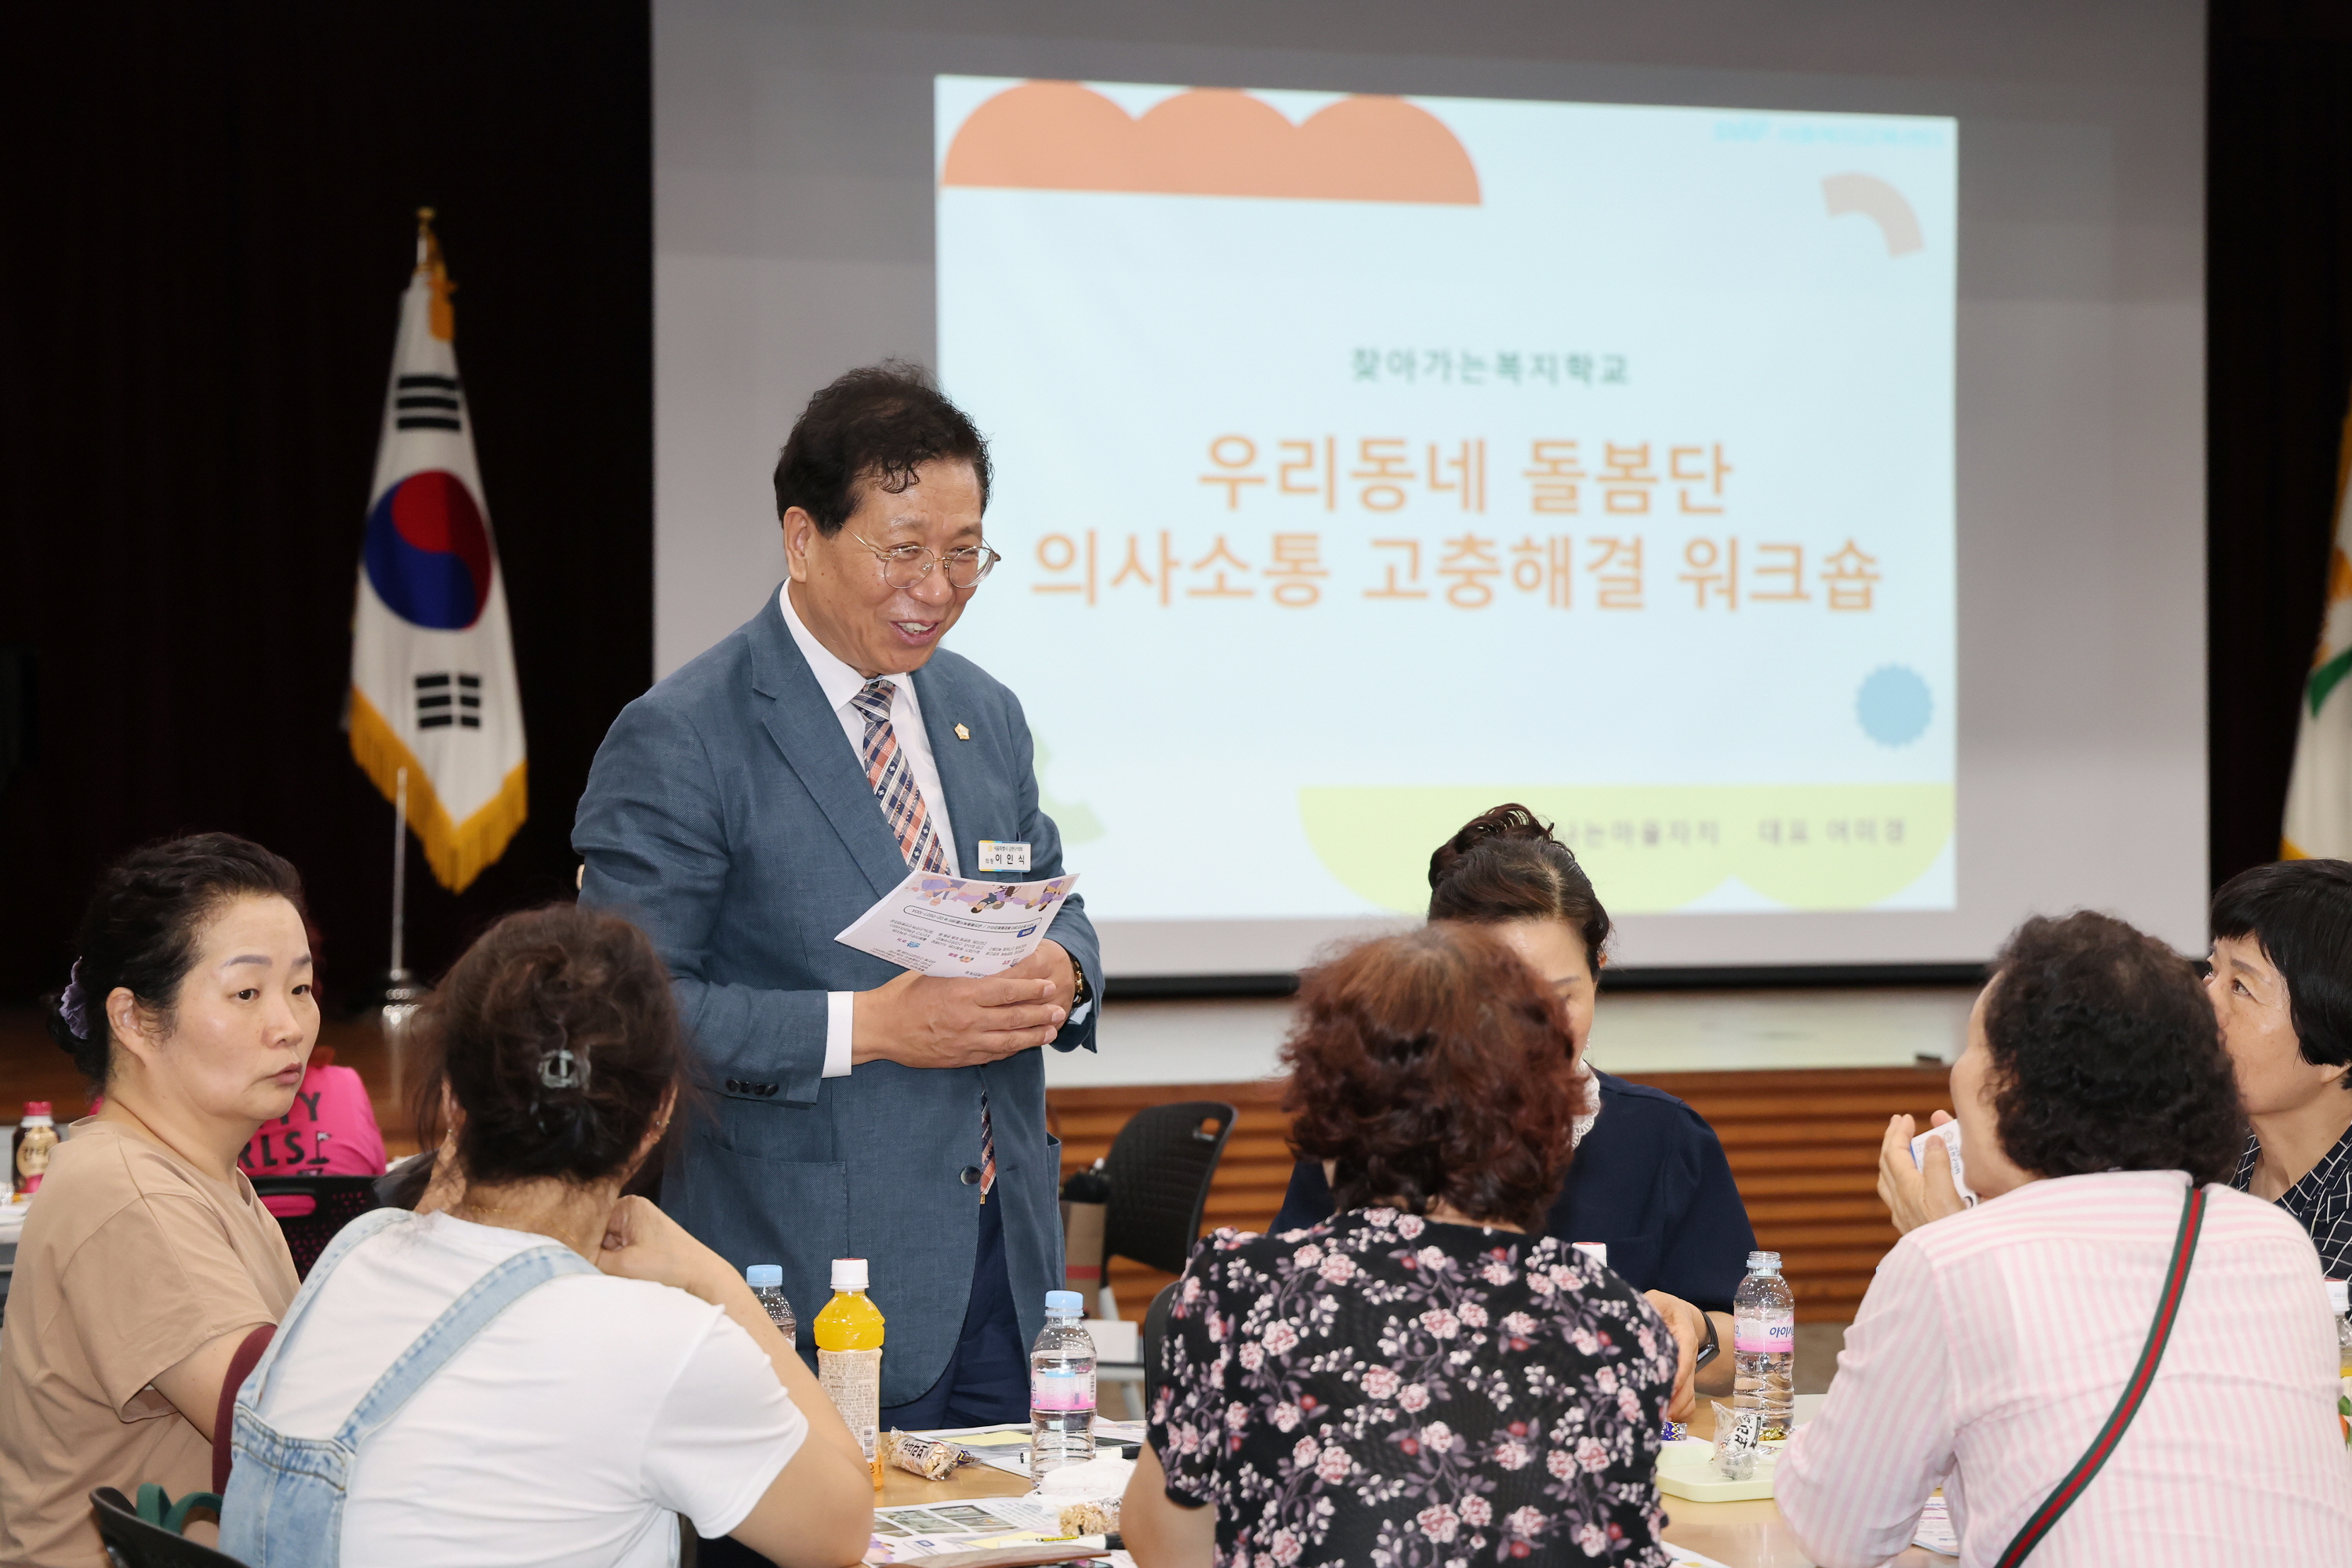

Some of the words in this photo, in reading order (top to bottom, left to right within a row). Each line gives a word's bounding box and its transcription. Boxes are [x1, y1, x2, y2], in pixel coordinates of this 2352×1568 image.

[1352, 347, 1629, 384] 찾아가는복지학교
[1200, 435, 1487, 513] 우리동네
[1523, 440, 1733, 515] 돌봄단
[1033, 529, 1330, 608] 의사소통
[1364, 533, 1645, 610] 고충해결
[1679, 538, 1882, 612] 워크숍
